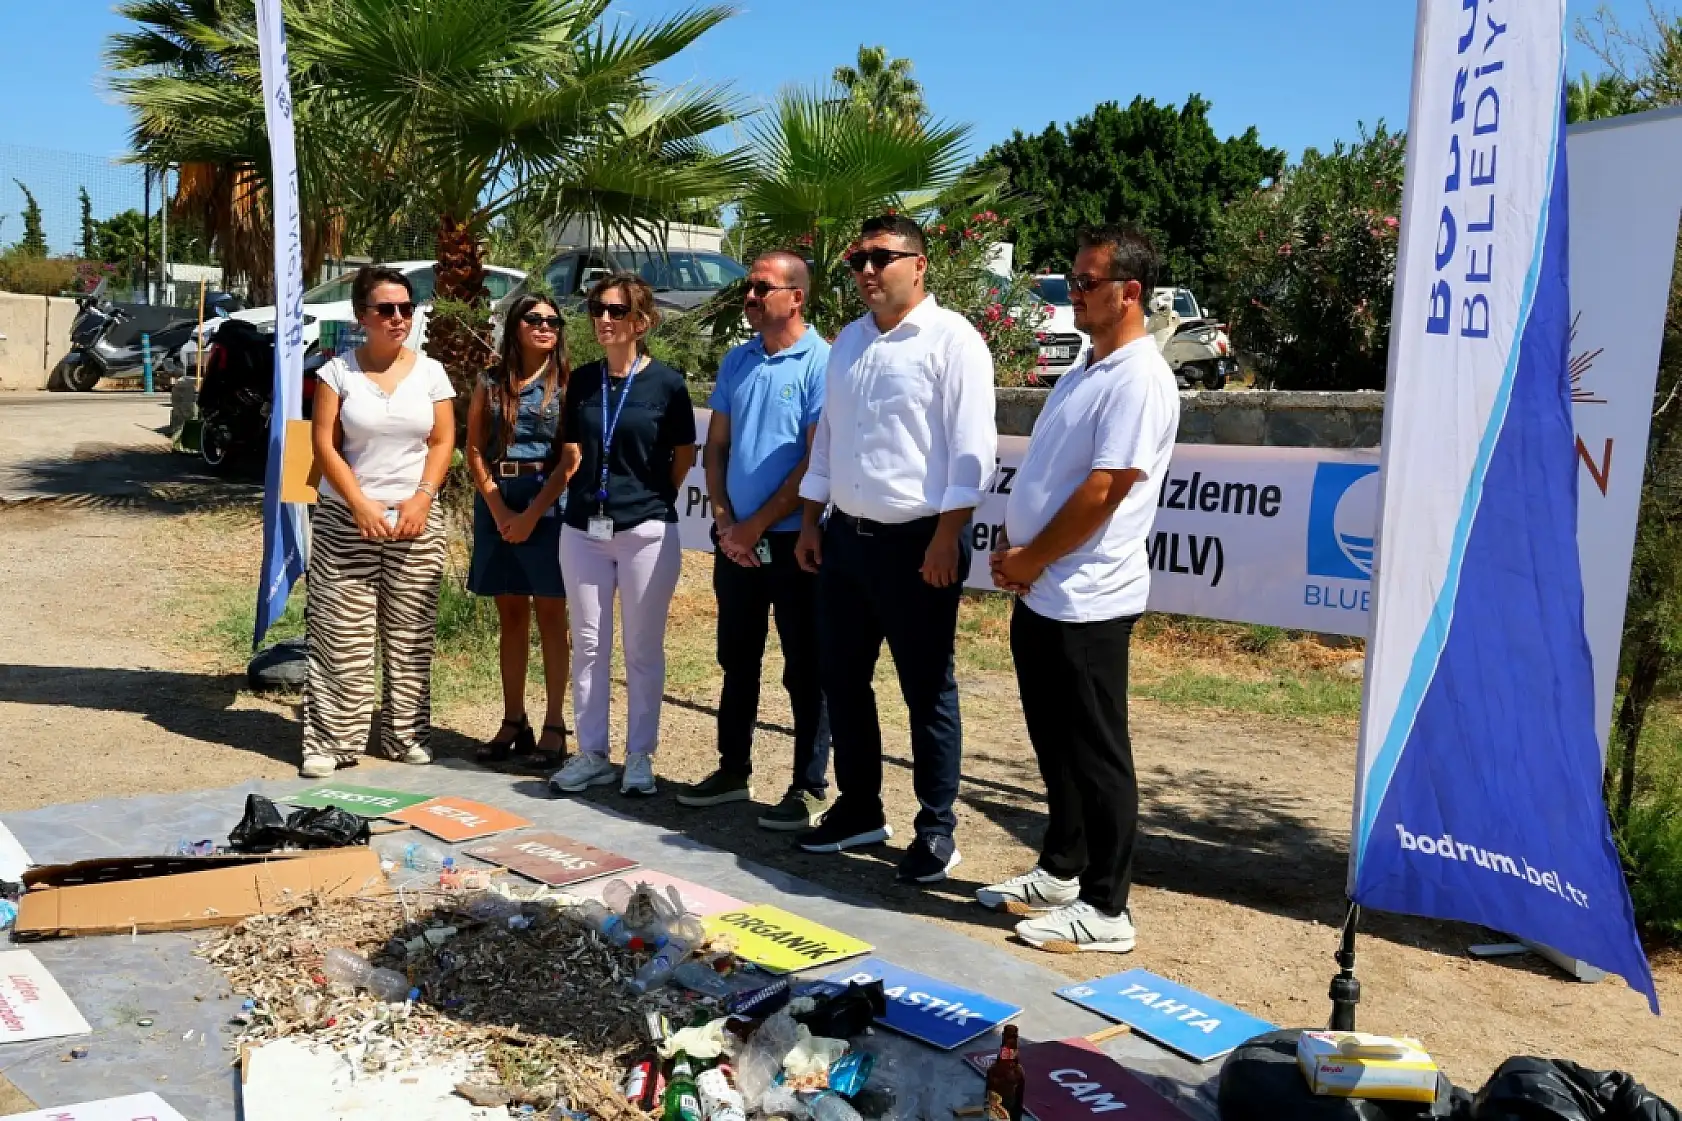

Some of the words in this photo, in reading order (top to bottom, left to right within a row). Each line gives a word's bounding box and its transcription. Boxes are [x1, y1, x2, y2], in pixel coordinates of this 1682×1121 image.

[1425, 0, 1478, 335] BODRU
[1460, 0, 1508, 338] BELEDİY
[1396, 823, 1590, 909] bodrum.bel.tr
[719, 912, 838, 960] ORGANİK
[840, 971, 984, 1027] PASTİK
[1118, 983, 1222, 1034] TAHTA
[1048, 1068, 1128, 1114] CAM
